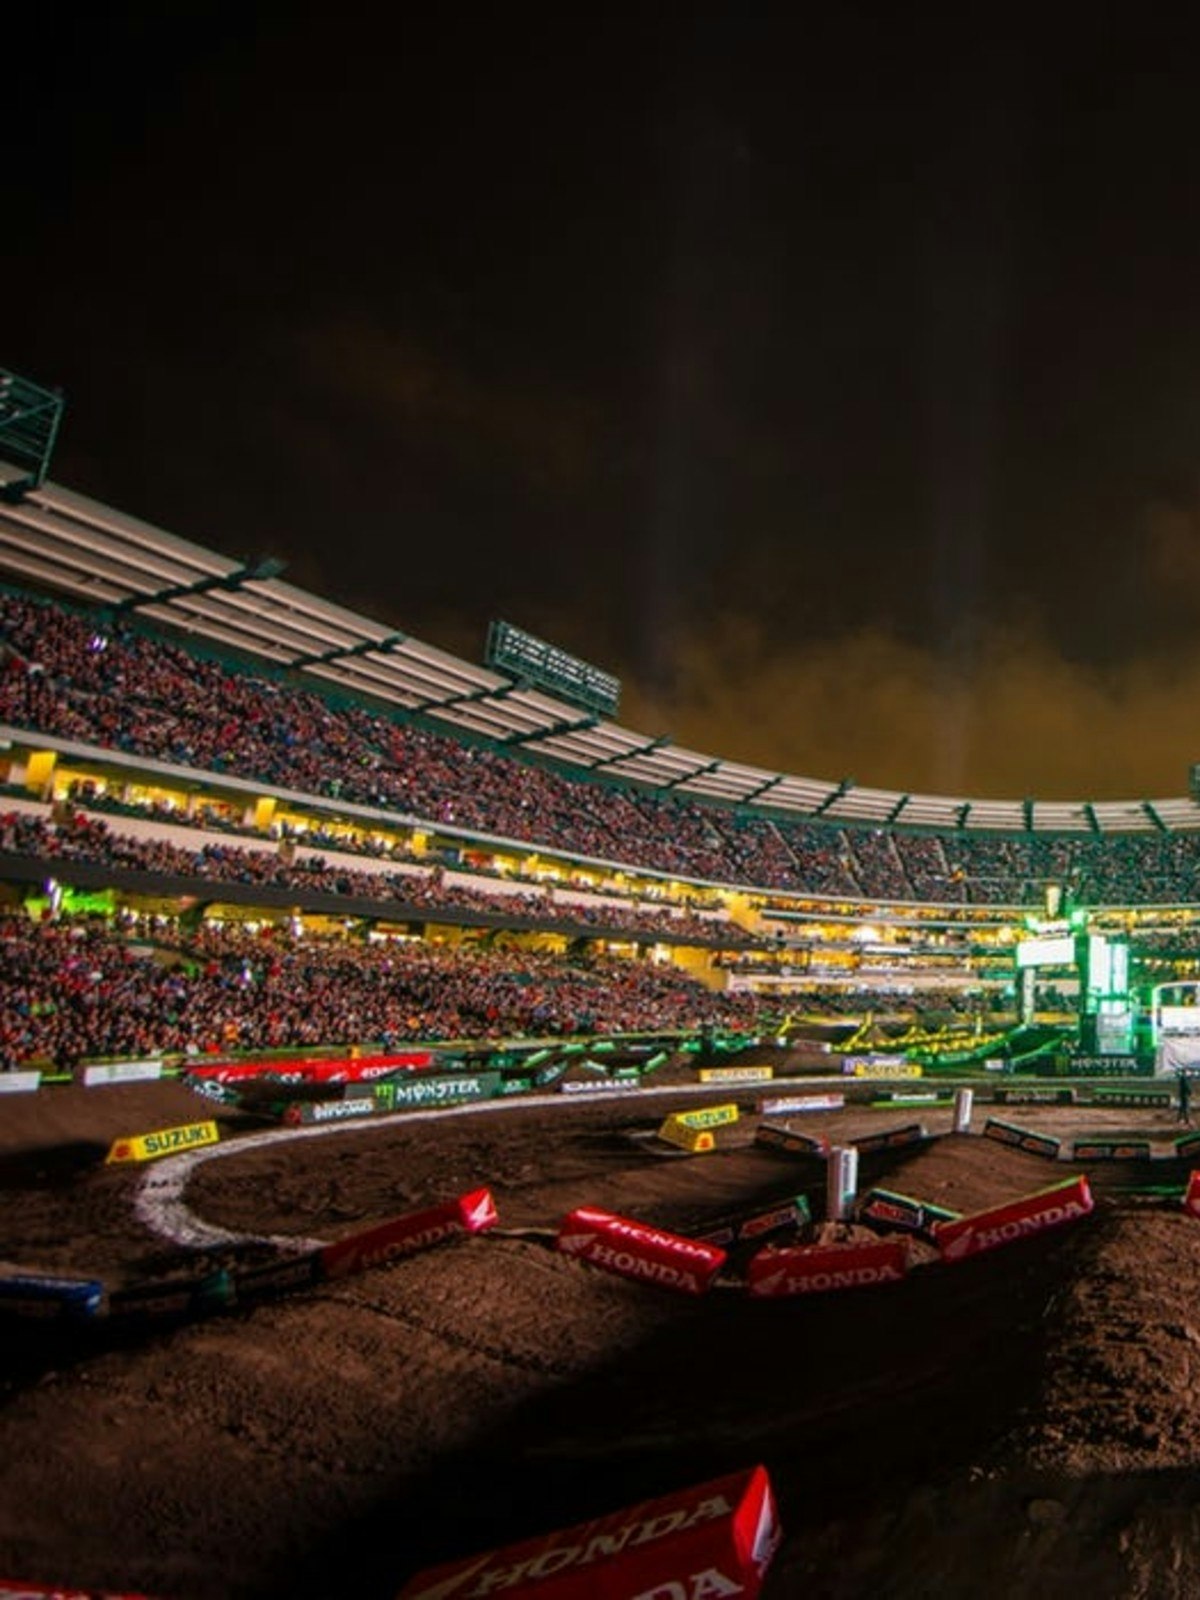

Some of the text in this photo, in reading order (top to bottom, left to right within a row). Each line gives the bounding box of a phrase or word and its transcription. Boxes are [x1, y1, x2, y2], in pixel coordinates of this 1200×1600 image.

[397, 1079, 481, 1101] MONSTER
[144, 1124, 213, 1153] SUZUKI
[974, 1199, 1084, 1245] HONDA
[588, 1241, 700, 1290] HONDA
[787, 1264, 902, 1293] HONDA
[475, 1493, 732, 1597] HONDA
